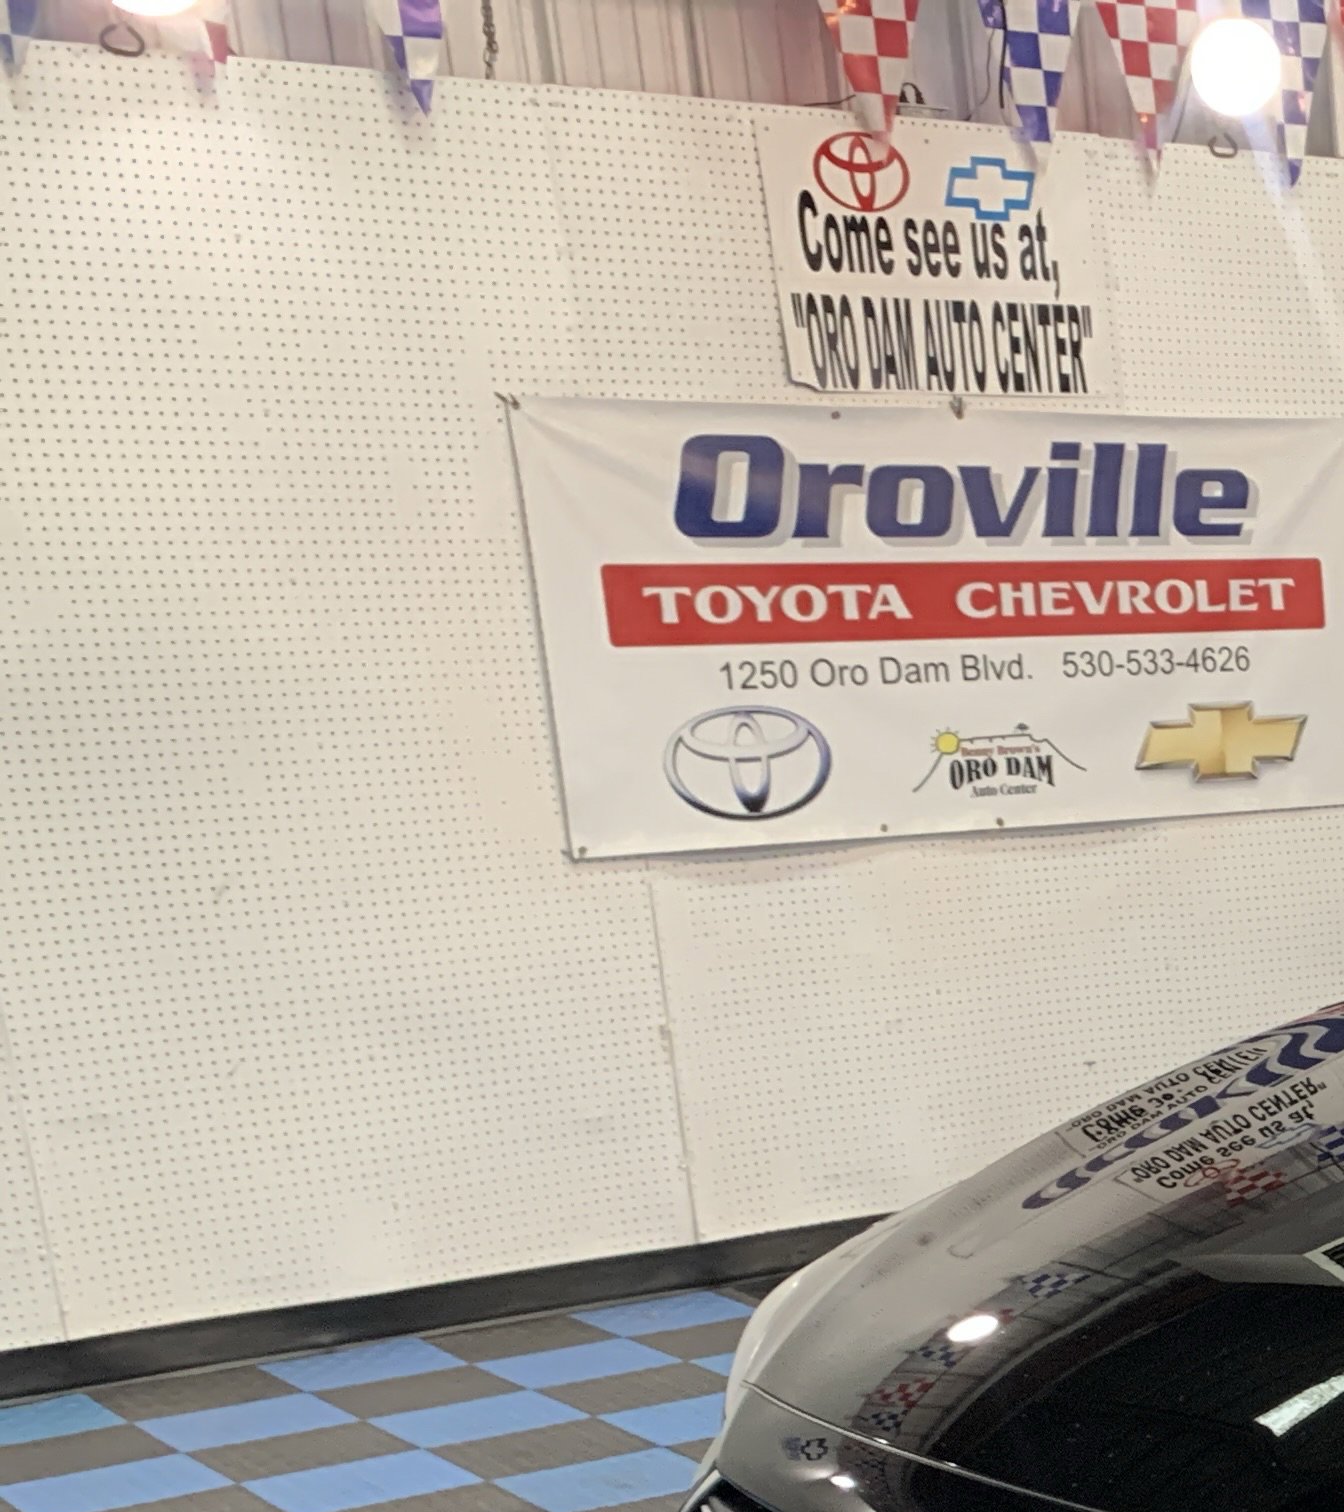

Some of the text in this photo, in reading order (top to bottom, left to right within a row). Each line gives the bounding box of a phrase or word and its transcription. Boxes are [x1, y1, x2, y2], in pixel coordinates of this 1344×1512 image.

[798, 189, 1060, 299] Come see us at,
[791, 292, 1093, 394] "ORO DAM AUTO CENTER"
[674, 434, 1253, 541] Oroville
[642, 577, 1295, 624] TOYOTA CHEVROLET
[719, 645, 1251, 691] 1250 Oro Dam Blvd. 530-533-4626
[950, 754, 1056, 790] ORO DAM
[970, 783, 1038, 798] Auto Center
